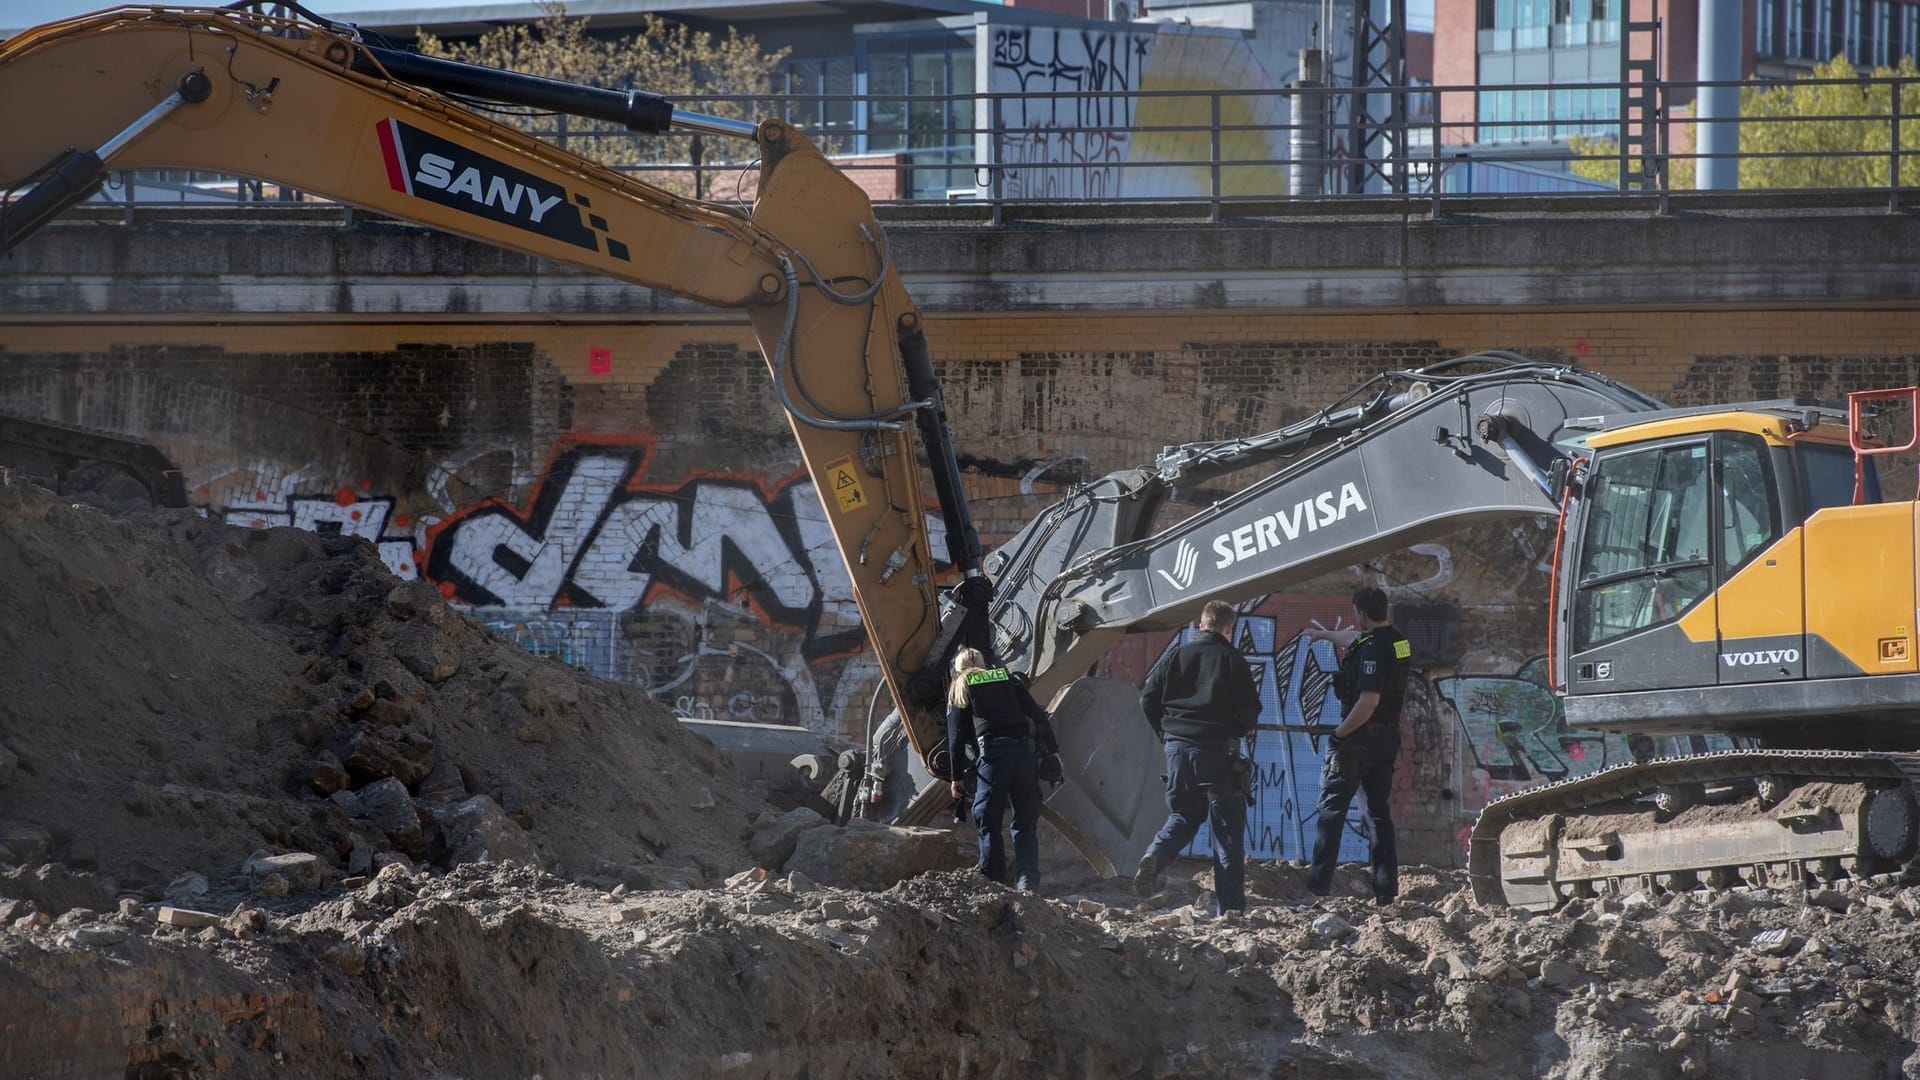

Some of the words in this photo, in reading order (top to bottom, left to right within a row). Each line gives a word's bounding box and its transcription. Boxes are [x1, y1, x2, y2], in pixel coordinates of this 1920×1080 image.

[415, 153, 563, 223] SANY
[1212, 481, 1367, 570] SERVISA
[965, 669, 1008, 684] POLIZEI
[1721, 648, 1799, 667] VOLVO
